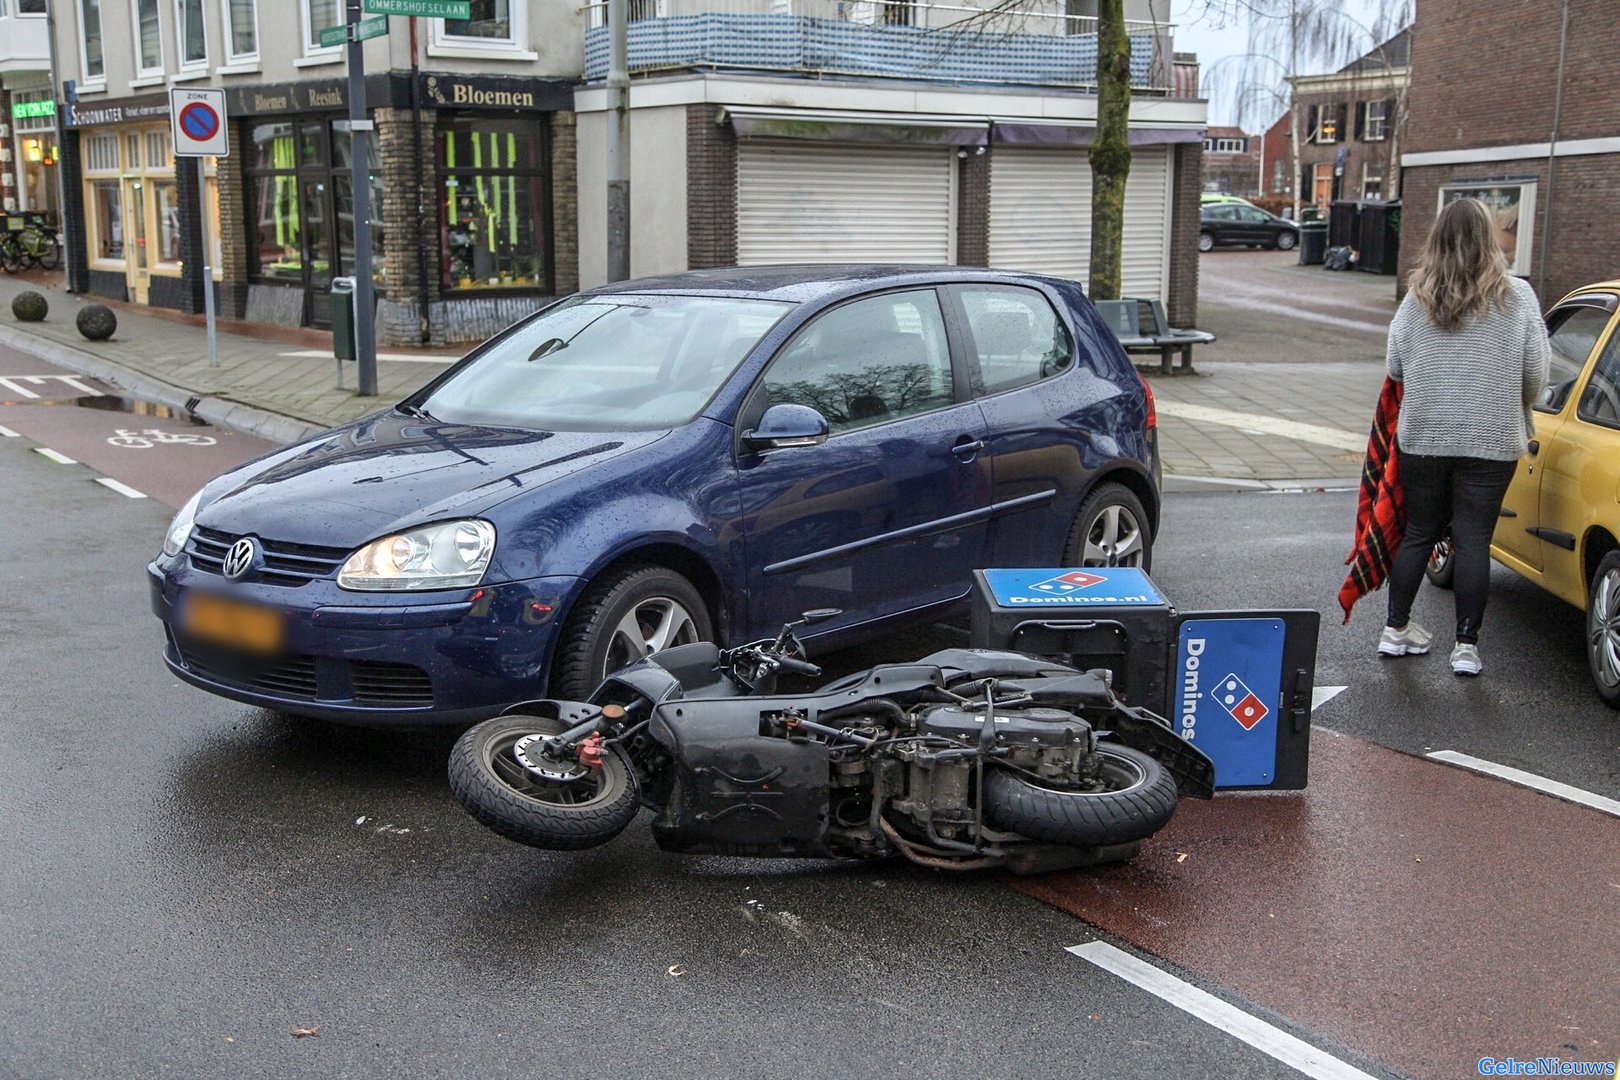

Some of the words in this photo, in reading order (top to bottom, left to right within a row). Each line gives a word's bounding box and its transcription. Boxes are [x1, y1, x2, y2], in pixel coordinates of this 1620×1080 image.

[369, 0, 465, 15] OMMERSHOFSELAAN
[255, 94, 287, 111] Bloemen
[309, 87, 342, 106] Reesink
[453, 84, 533, 106] Bloemen
[1010, 595, 1148, 603] Dominos.nl
[1181, 638, 1206, 741] Dominos
